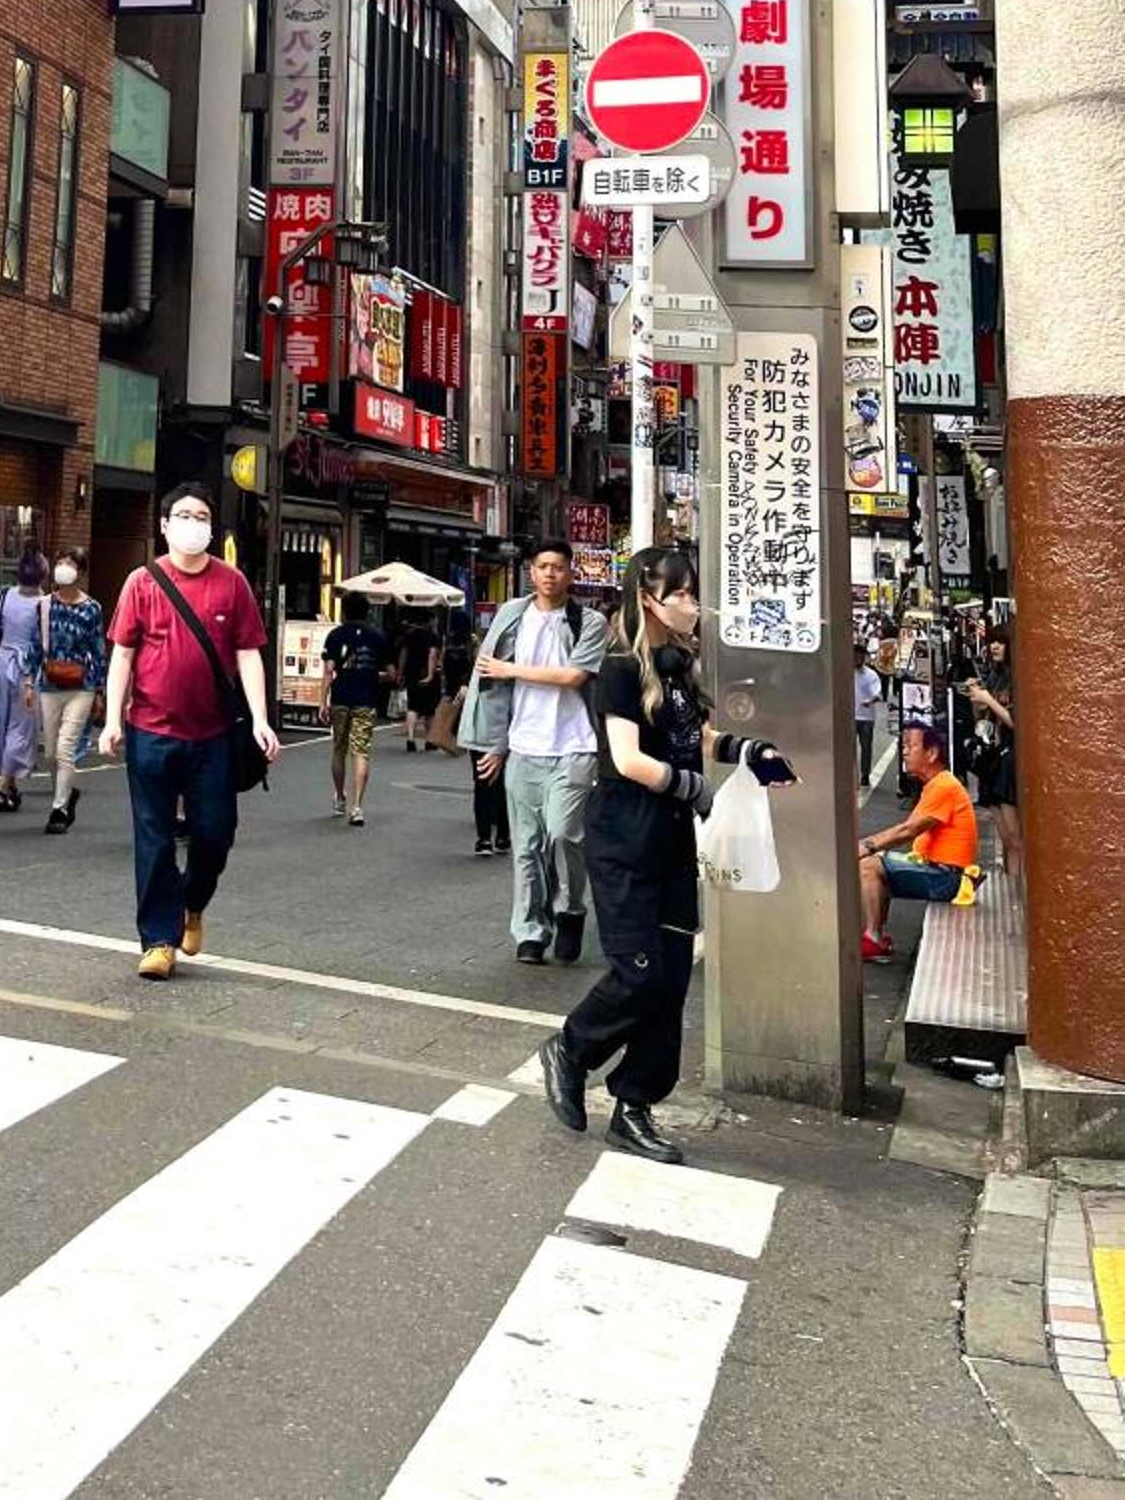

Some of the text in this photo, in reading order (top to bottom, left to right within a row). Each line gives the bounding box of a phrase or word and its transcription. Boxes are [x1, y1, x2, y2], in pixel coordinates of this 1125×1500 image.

[739, 0, 790, 241] 劇場通り
[527, 169, 564, 185] B1F
[593, 166, 700, 195] 自転車を除く
[273, 192, 332, 221] 焼肉
[532, 317, 556, 331] 4F
[892, 275, 942, 366] 本陣
[745, 359, 758, 383] For
[727, 384, 742, 444] Security
[745, 389, 758, 423] Your
[743, 429, 759, 476] Safety
[762, 358, 788, 594] 防犯カメラ作動中
[727, 450, 742, 504] Camera
[790, 348, 813, 611] みなさまの安全を守ります
[728, 508, 742, 526] in
[726, 533, 742, 606] Operation
